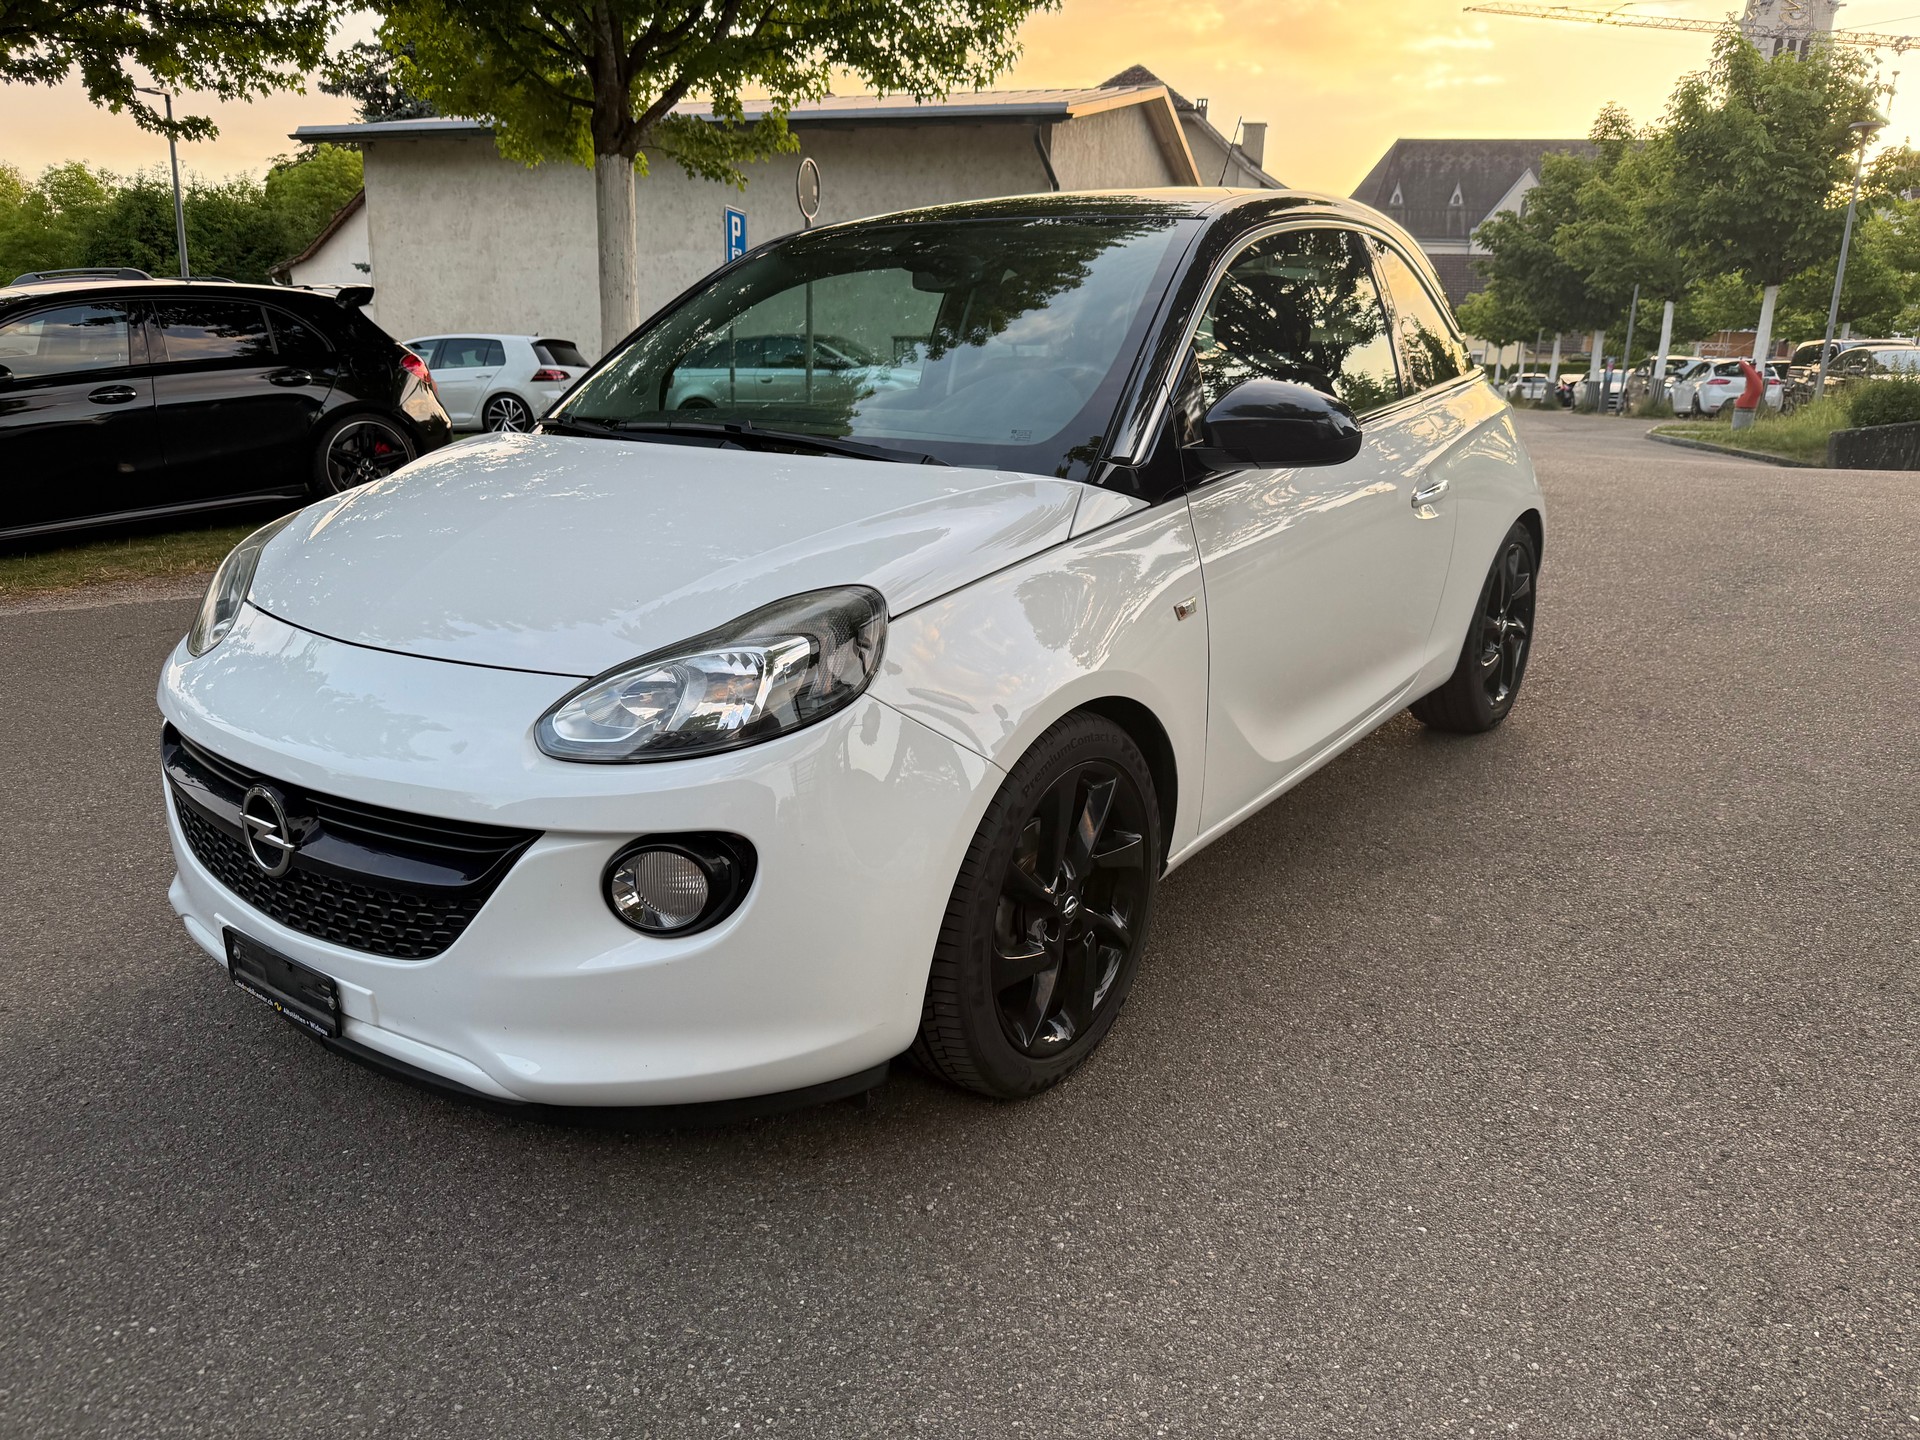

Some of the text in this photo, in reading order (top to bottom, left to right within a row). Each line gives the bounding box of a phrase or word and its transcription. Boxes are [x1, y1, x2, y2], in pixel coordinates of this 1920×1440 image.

[731, 215, 742, 246] P
[1022, 732, 1118, 798] PremiumContact 6
